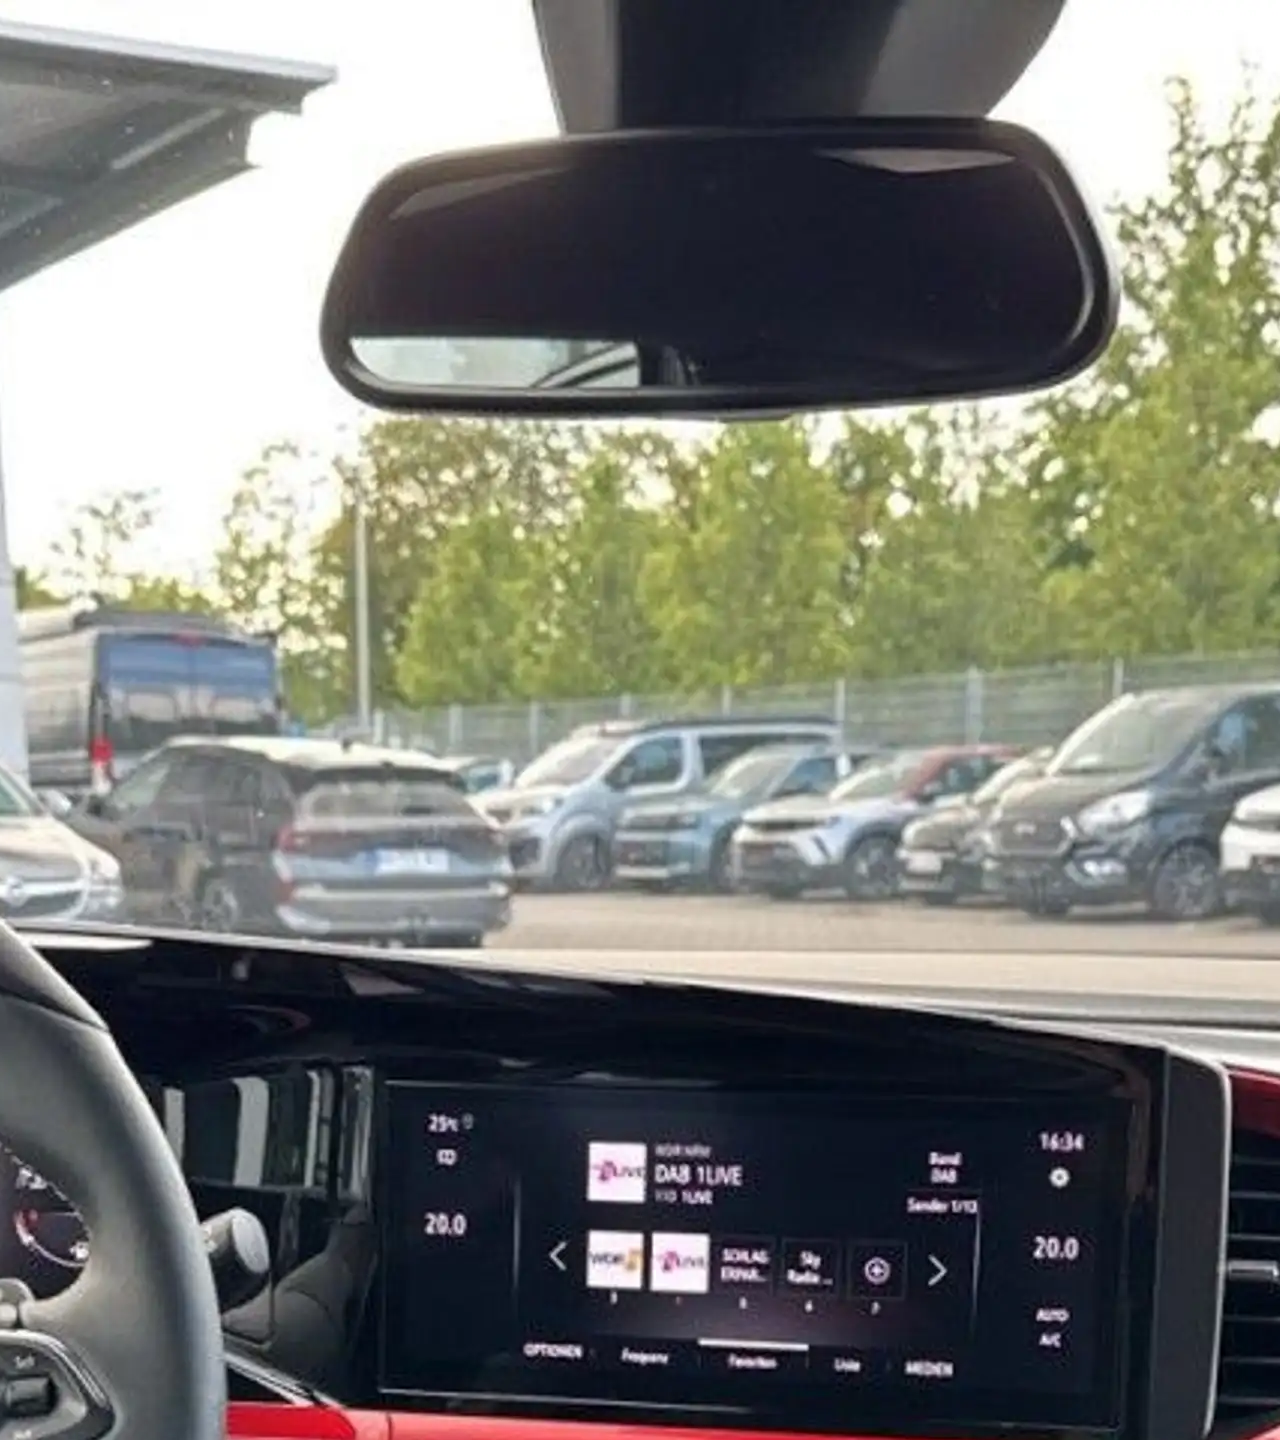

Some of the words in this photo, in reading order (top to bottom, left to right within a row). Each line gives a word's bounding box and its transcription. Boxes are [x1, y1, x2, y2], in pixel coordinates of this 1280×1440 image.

[1039, 1132, 1084, 1151] 16:34
[655, 1163, 690, 1185] DAB
[930, 1167, 958, 1184] DAB
[424, 1211, 468, 1236] 20.0
[1033, 1236, 1080, 1261] 20.0
[522, 1343, 583, 1358] OPTIONEN
[904, 1360, 955, 1378] MEDIEN
